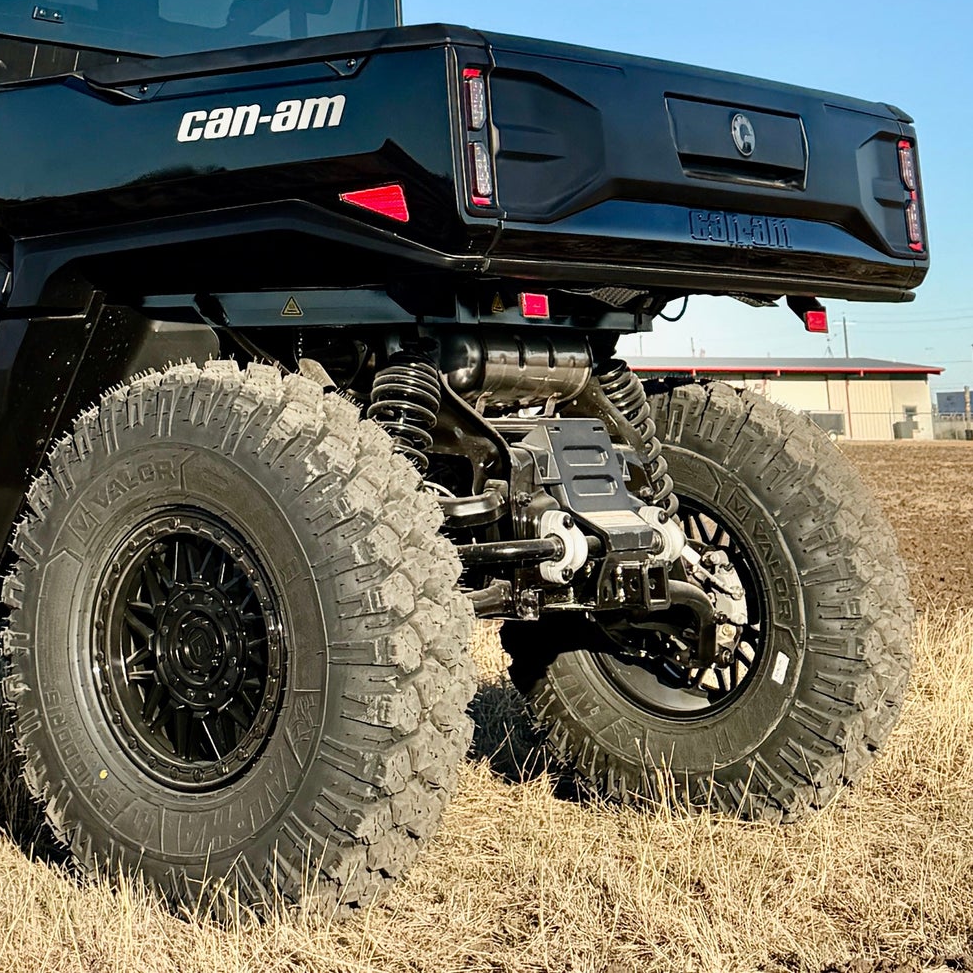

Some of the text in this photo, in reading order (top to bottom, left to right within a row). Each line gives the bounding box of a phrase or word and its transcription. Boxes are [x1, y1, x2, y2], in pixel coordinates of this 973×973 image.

[177, 94, 346, 142] can-am
[689, 210, 792, 248] can-am
[89, 459, 176, 508] VALOR
[751, 519, 794, 622] VALOR
